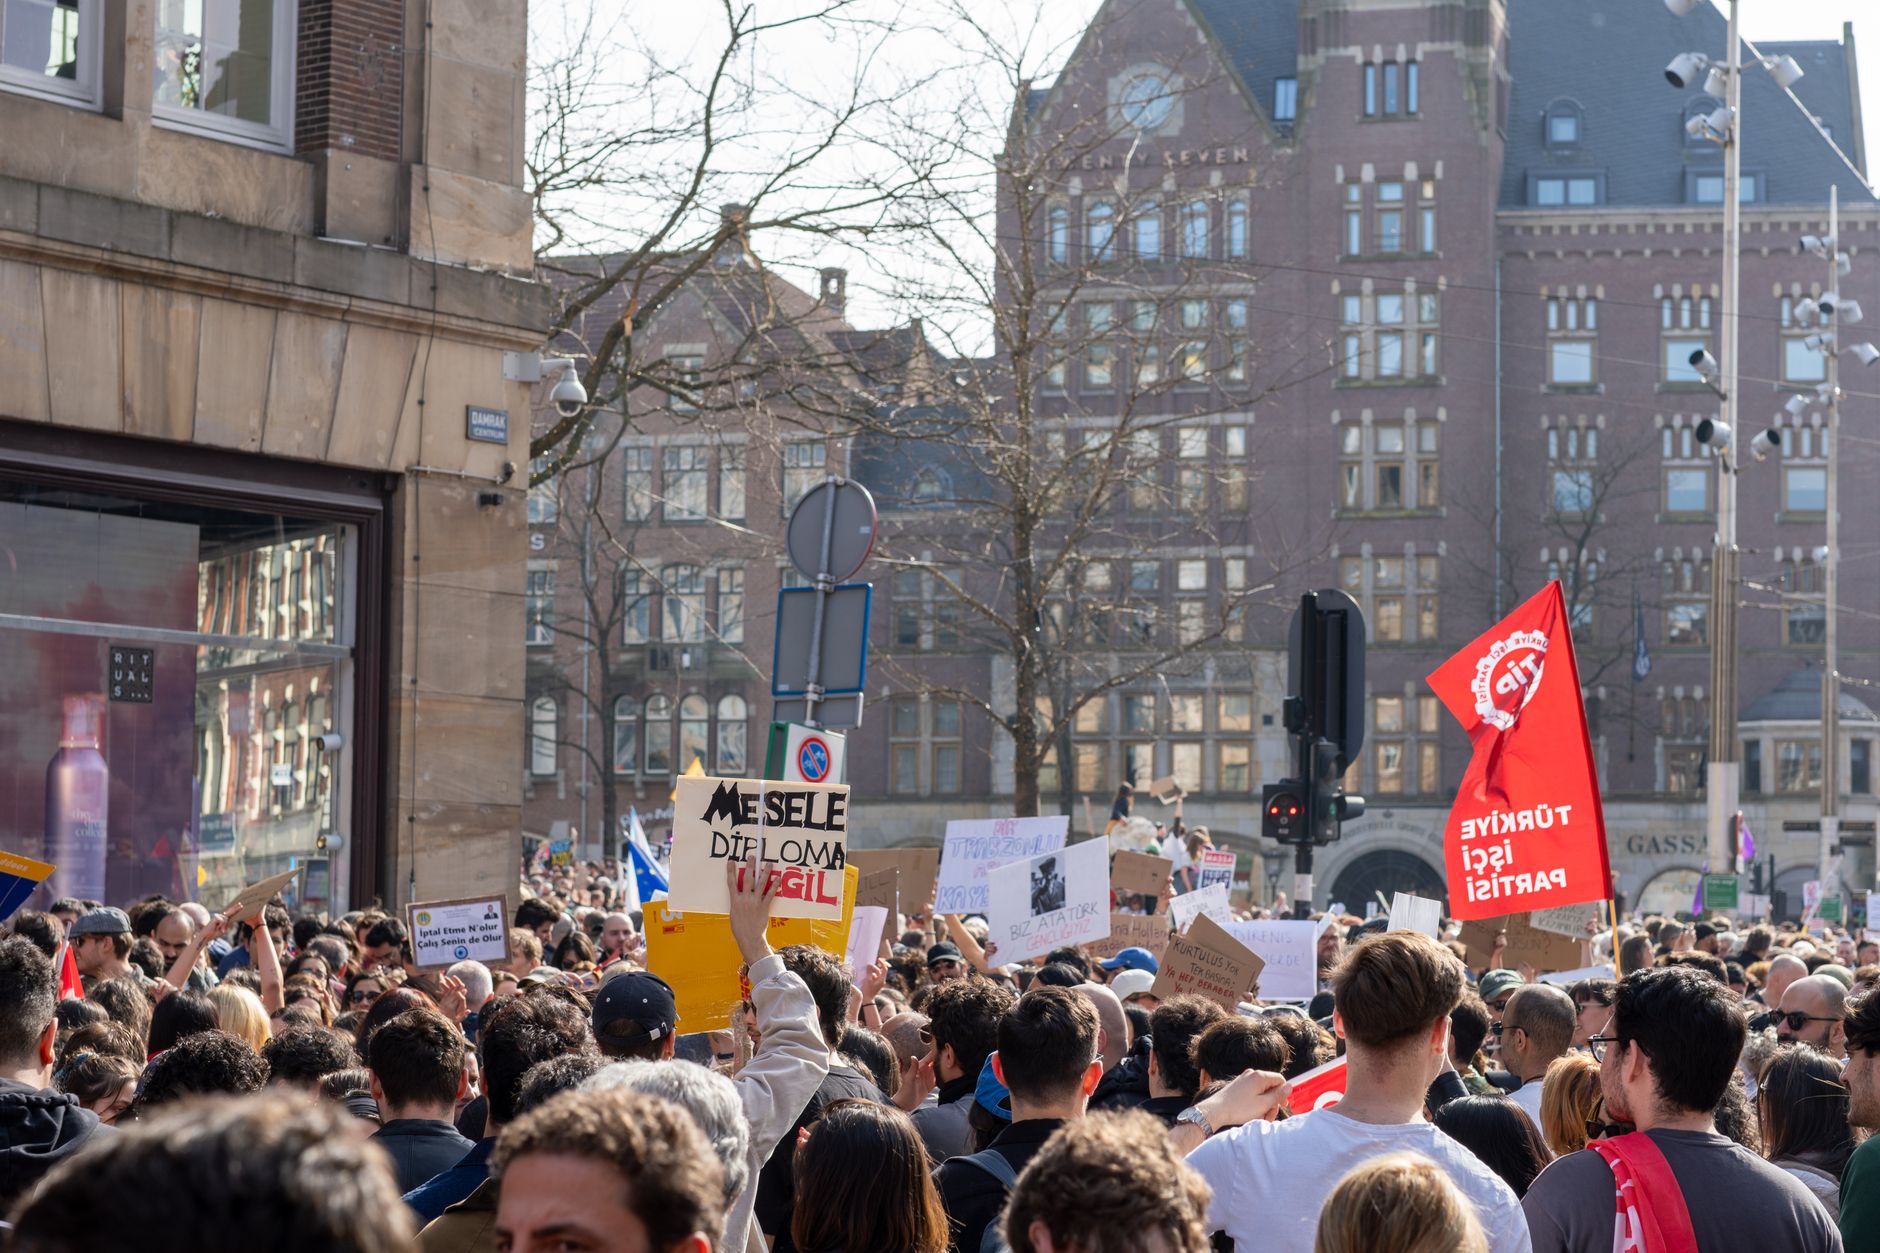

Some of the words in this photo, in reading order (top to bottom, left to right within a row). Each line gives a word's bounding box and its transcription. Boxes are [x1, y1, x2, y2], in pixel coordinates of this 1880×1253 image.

[1163, 147, 1249, 167] SEVEN
[471, 411, 506, 428] DAMRAK
[699, 780, 848, 833] MESELE
[709, 830, 846, 870] DİPLOMA
[417, 940, 439, 950] Çalış
[441, 936, 466, 946] Senin
[468, 936, 480, 945] de
[482, 934, 502, 943] Olur
[419, 927, 441, 938] İptal
[443, 926, 466, 935] Etme
[1196, 978, 1236, 999] BERABER
